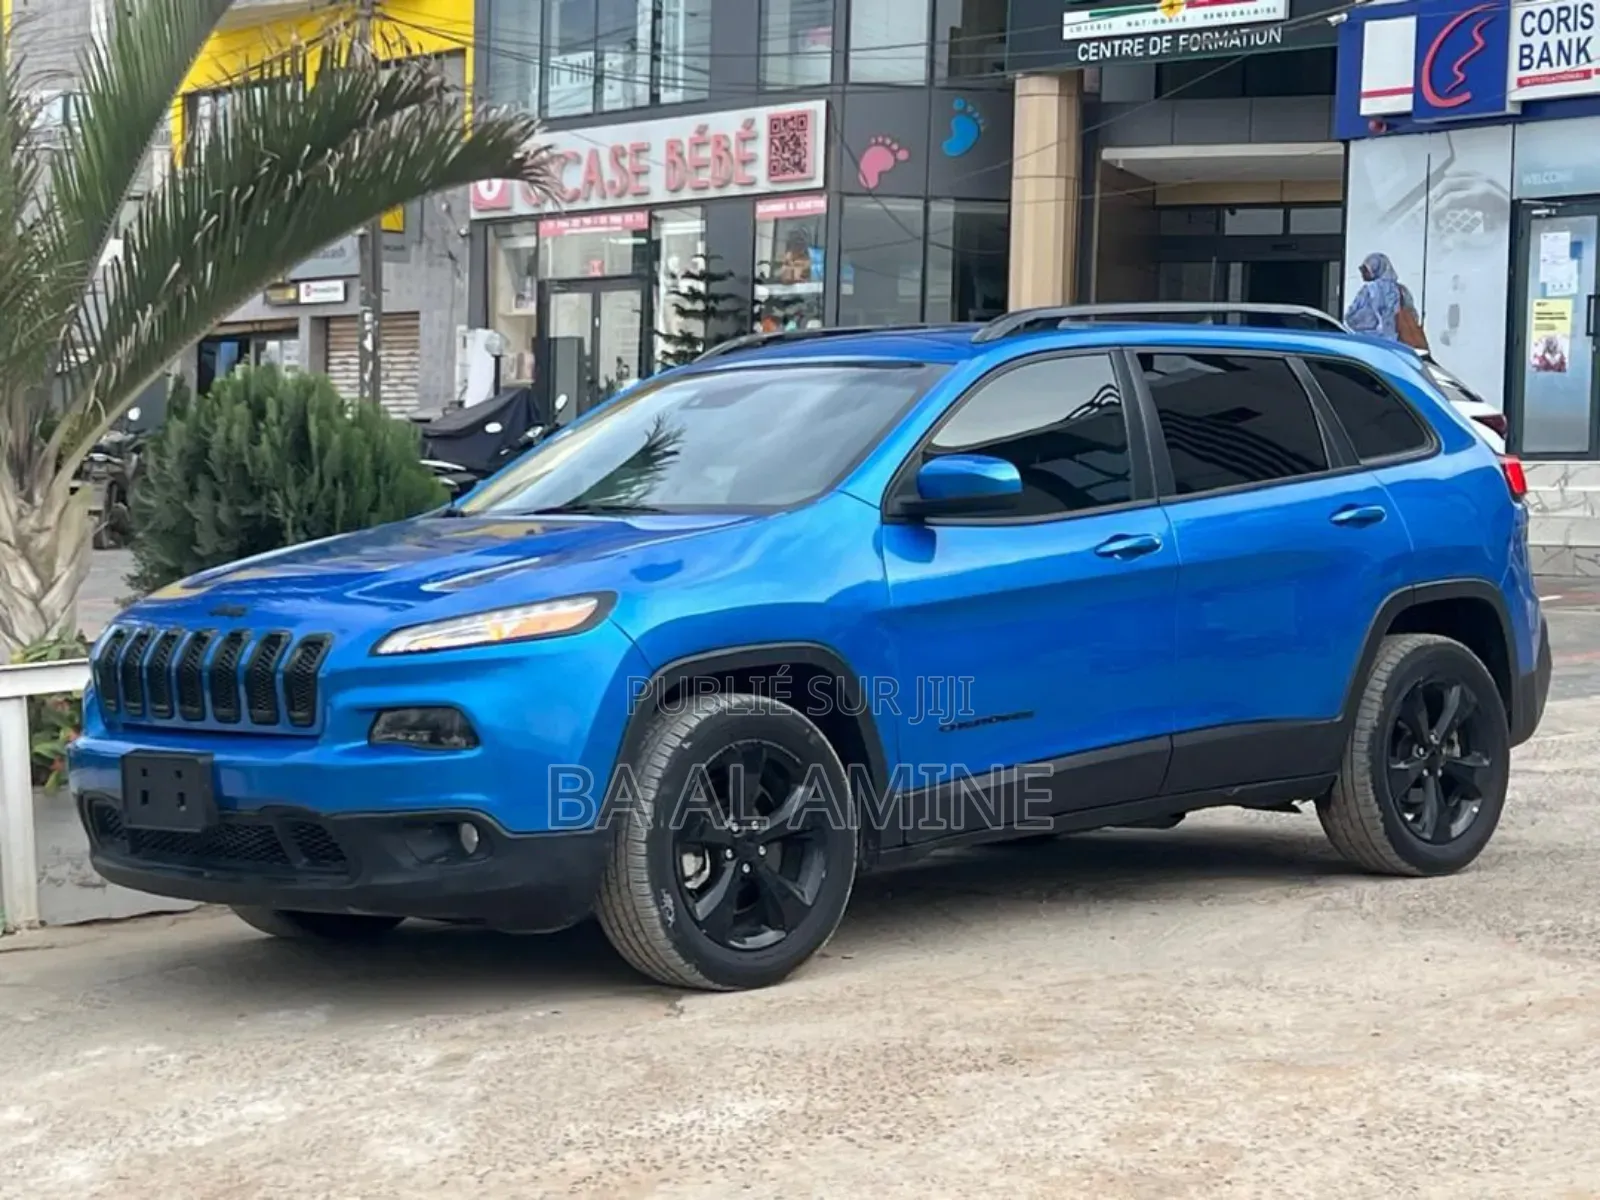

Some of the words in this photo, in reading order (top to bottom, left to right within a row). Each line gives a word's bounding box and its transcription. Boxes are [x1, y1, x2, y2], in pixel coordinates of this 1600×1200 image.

[1521, 3, 1594, 37] CORIS
[1077, 37, 1144, 62] CENTRE
[1149, 35, 1173, 56] DE
[1179, 27, 1282, 53] FORMATION
[1519, 36, 1593, 71] BANK
[665, 118, 758, 193] BÉBÉ
